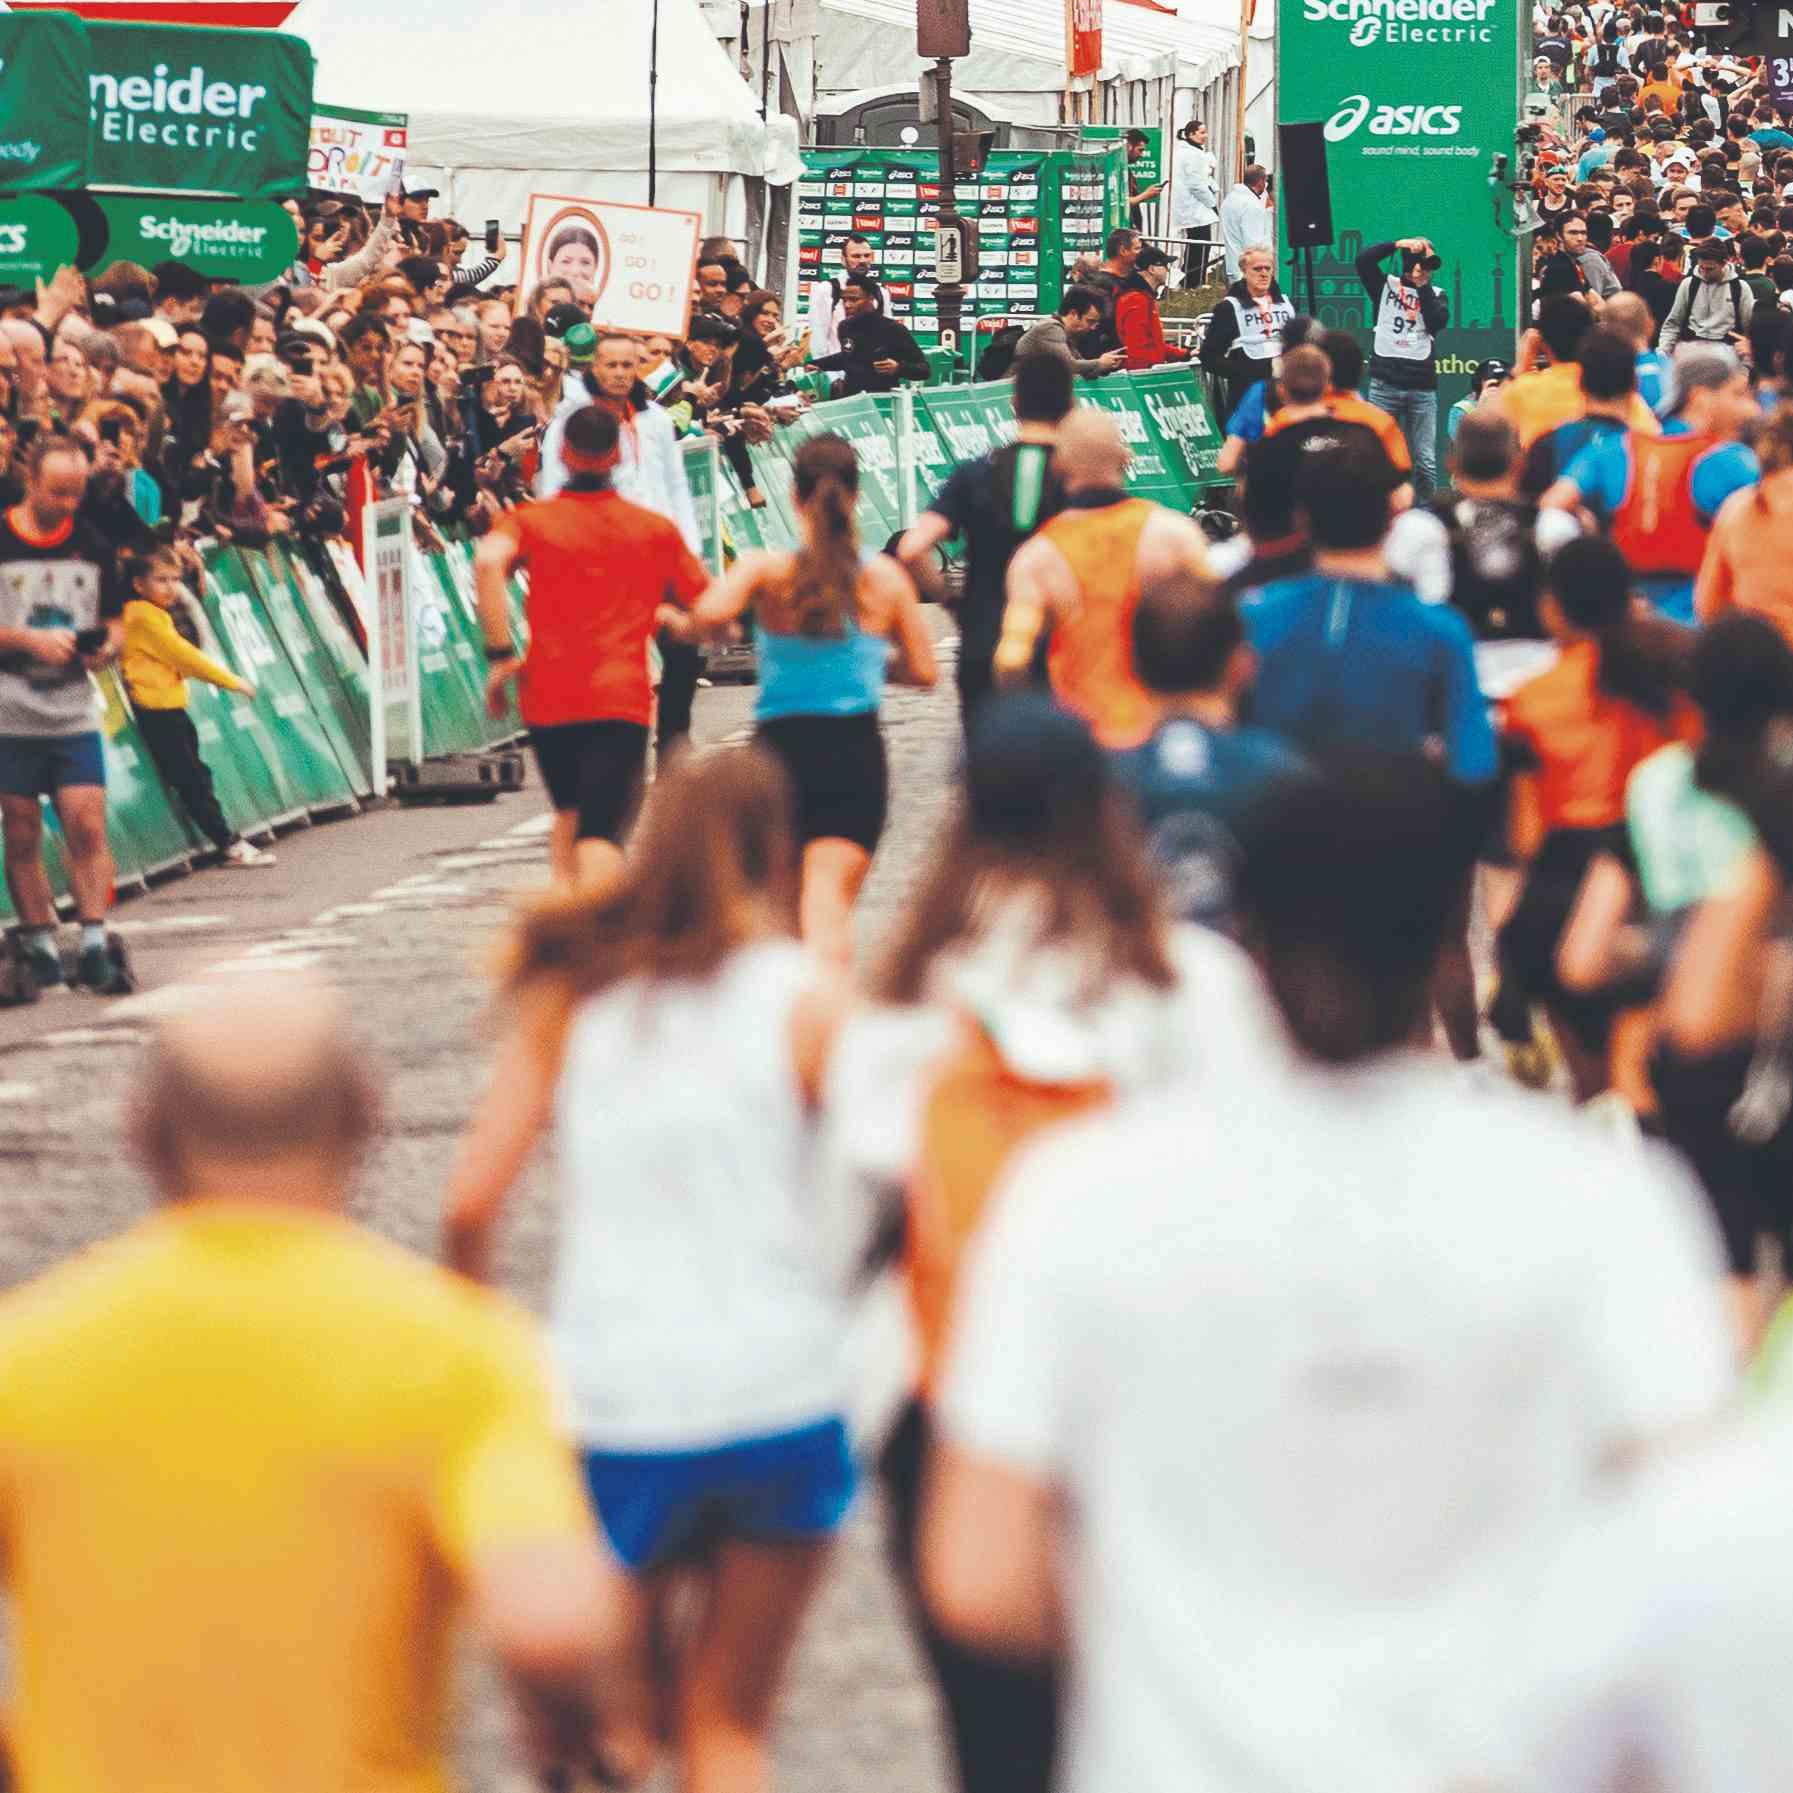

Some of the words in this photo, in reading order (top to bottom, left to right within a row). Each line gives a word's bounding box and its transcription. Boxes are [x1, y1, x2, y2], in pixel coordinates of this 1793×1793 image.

[1386, 23, 1492, 42] Electric
[89, 64, 266, 118] neider
[103, 112, 257, 151] Electric
[1362, 146, 1392, 157] sound
[1423, 146, 1453, 157] sound
[1455, 146, 1480, 158] body
[140, 215, 267, 244] Schneider
